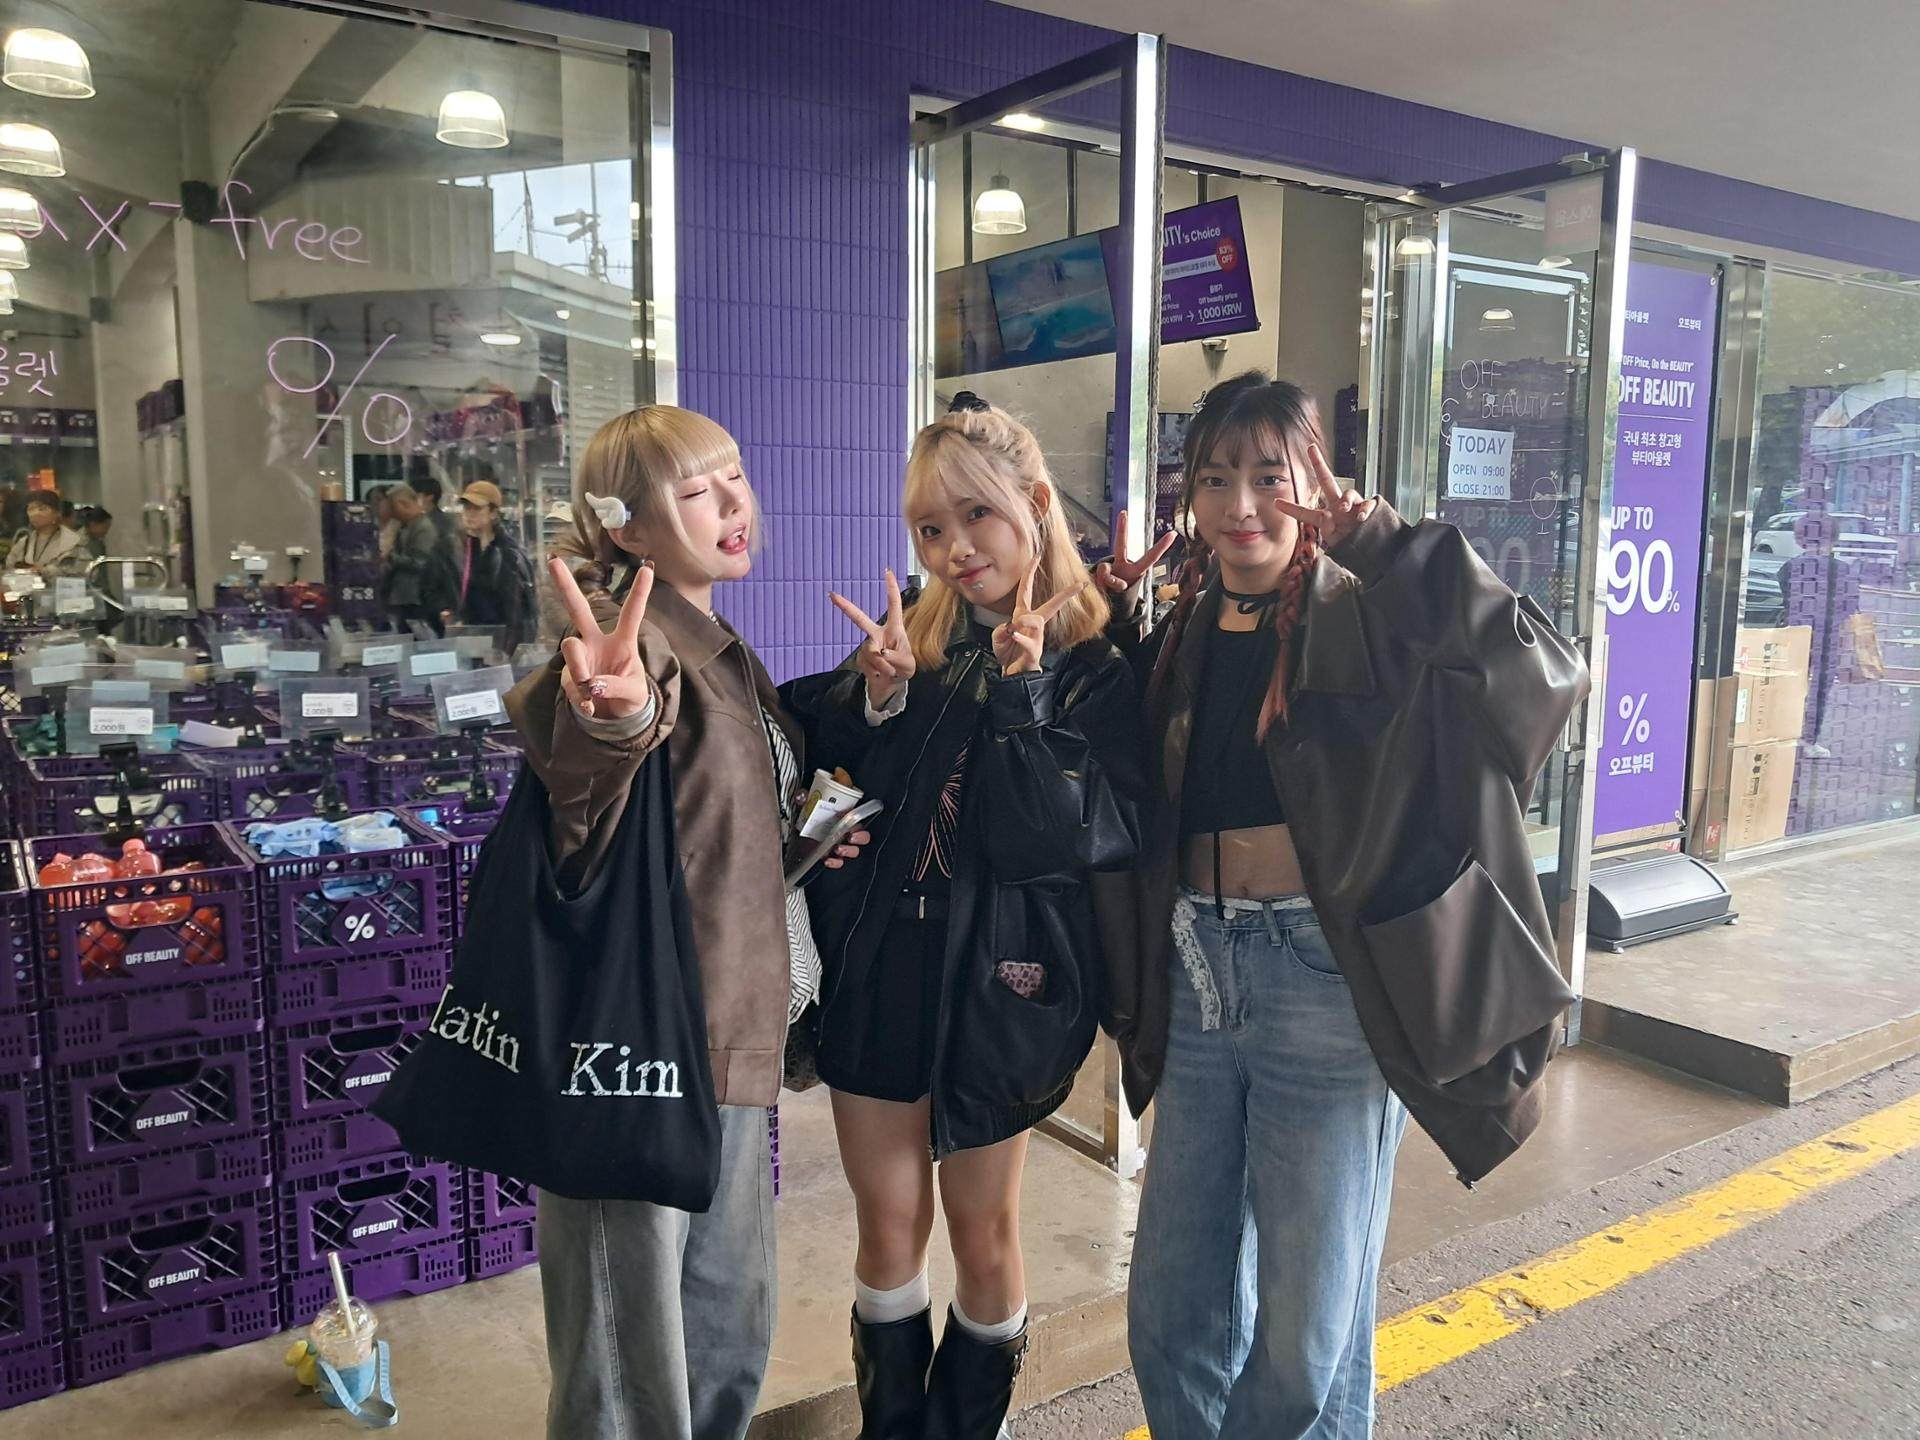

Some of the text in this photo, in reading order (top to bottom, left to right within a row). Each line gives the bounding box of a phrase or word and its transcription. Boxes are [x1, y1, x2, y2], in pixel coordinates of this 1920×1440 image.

[1191, 227, 1221, 243] Choice
[1198, 302, 1242, 323] 1,000 KRW
[1677, 317, 1702, 331] 오프뷰티
[1460, 359, 1502, 390] OFF
[1660, 359, 1669, 371] the
[267, 334, 412, 459] %
[1642, 377, 1696, 409] BEAUTY
[1481, 392, 1549, 420] BEAUTY
[1457, 434, 1507, 455] TODAY
[1623, 430, 1683, 449] 국내 최초 창고형
[1632, 449, 1672, 467] 뷰티아울렛
[1452, 464, 1505, 477] OPEN 09:00
[1452, 483, 1505, 496] CLOSE 21:00
[1611, 506, 1655, 531] UP TO
[1618, 693, 1650, 746] %
[1608, 752, 1655, 776] 오프뷰티
[344, 912, 375, 942] %
[125, 948, 179, 966] OFF BEAUTY
[345, 1071, 391, 1089] OFF BEAUTY
[561, 1042, 683, 1098] Kim
[136, 1111, 189, 1130] OFF BEAUTY
[352, 1218, 398, 1239] OFF BEAUTY
[149, 1268, 200, 1289] OFF BEAUTY
